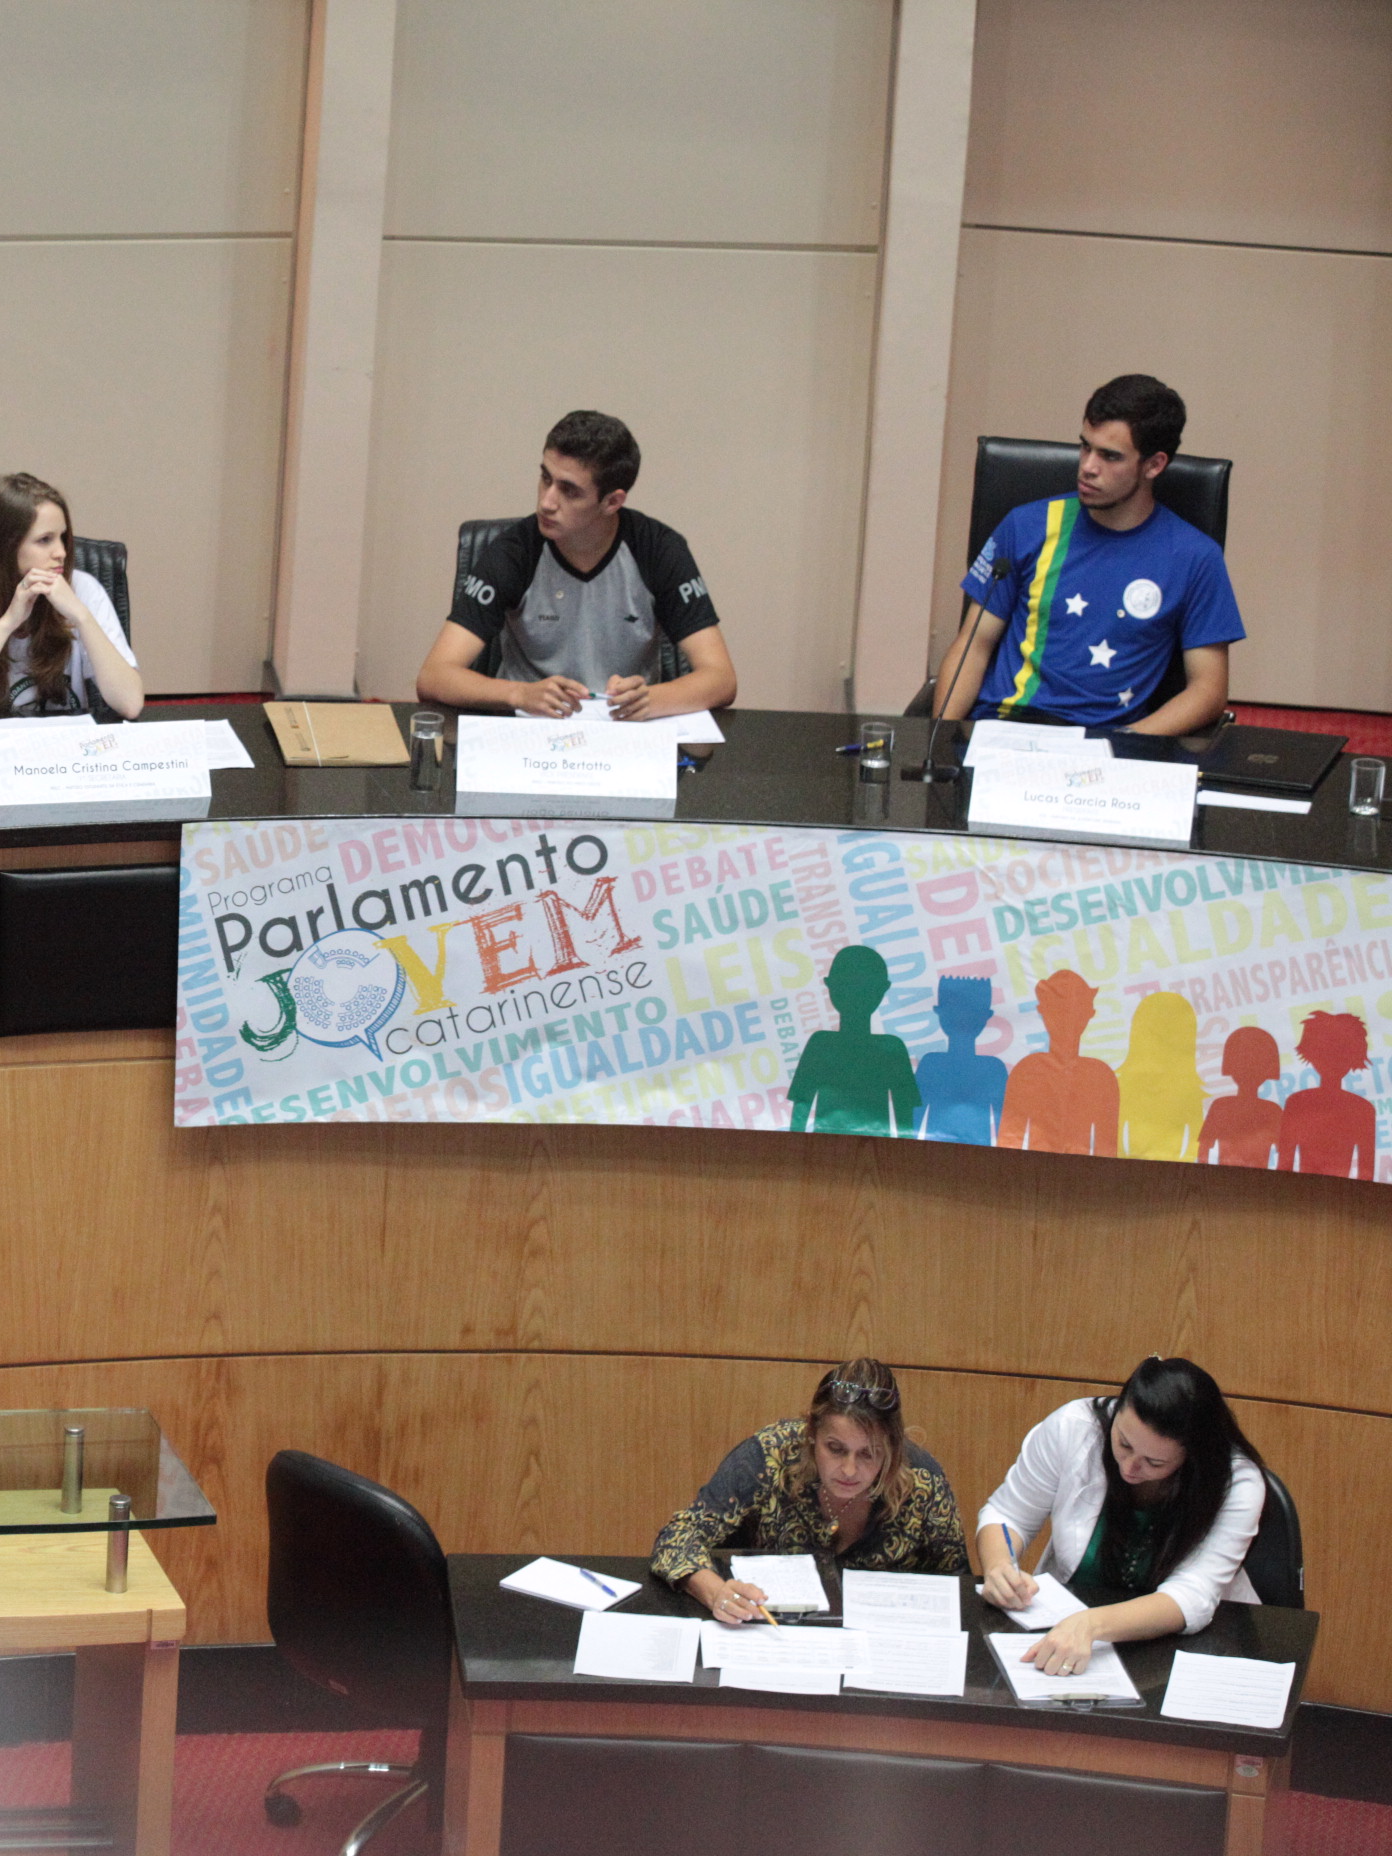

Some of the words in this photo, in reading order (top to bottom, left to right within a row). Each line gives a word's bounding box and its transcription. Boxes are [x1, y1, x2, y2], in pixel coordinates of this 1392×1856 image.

[14, 764, 67, 776] Manoela
[72, 762, 118, 774] Cristina
[123, 758, 189, 773] Campestini
[522, 757, 557, 770] Tiago
[562, 758, 611, 772] Bertotto
[1024, 790, 1059, 804] Lucas
[1111, 797, 1141, 811] Rosa
[209, 866, 332, 915] Programa
[214, 834, 608, 972] Parlamento
[632, 837, 789, 903] DEBATE
[652, 879, 799, 950] SAÚDE
[1003, 874, 1392, 998] IGUALDADE
[665, 927, 814, 1016] LEIS
[386, 961, 653, 1055] catarinense
[502, 1002, 766, 1104] IGUALDADE
